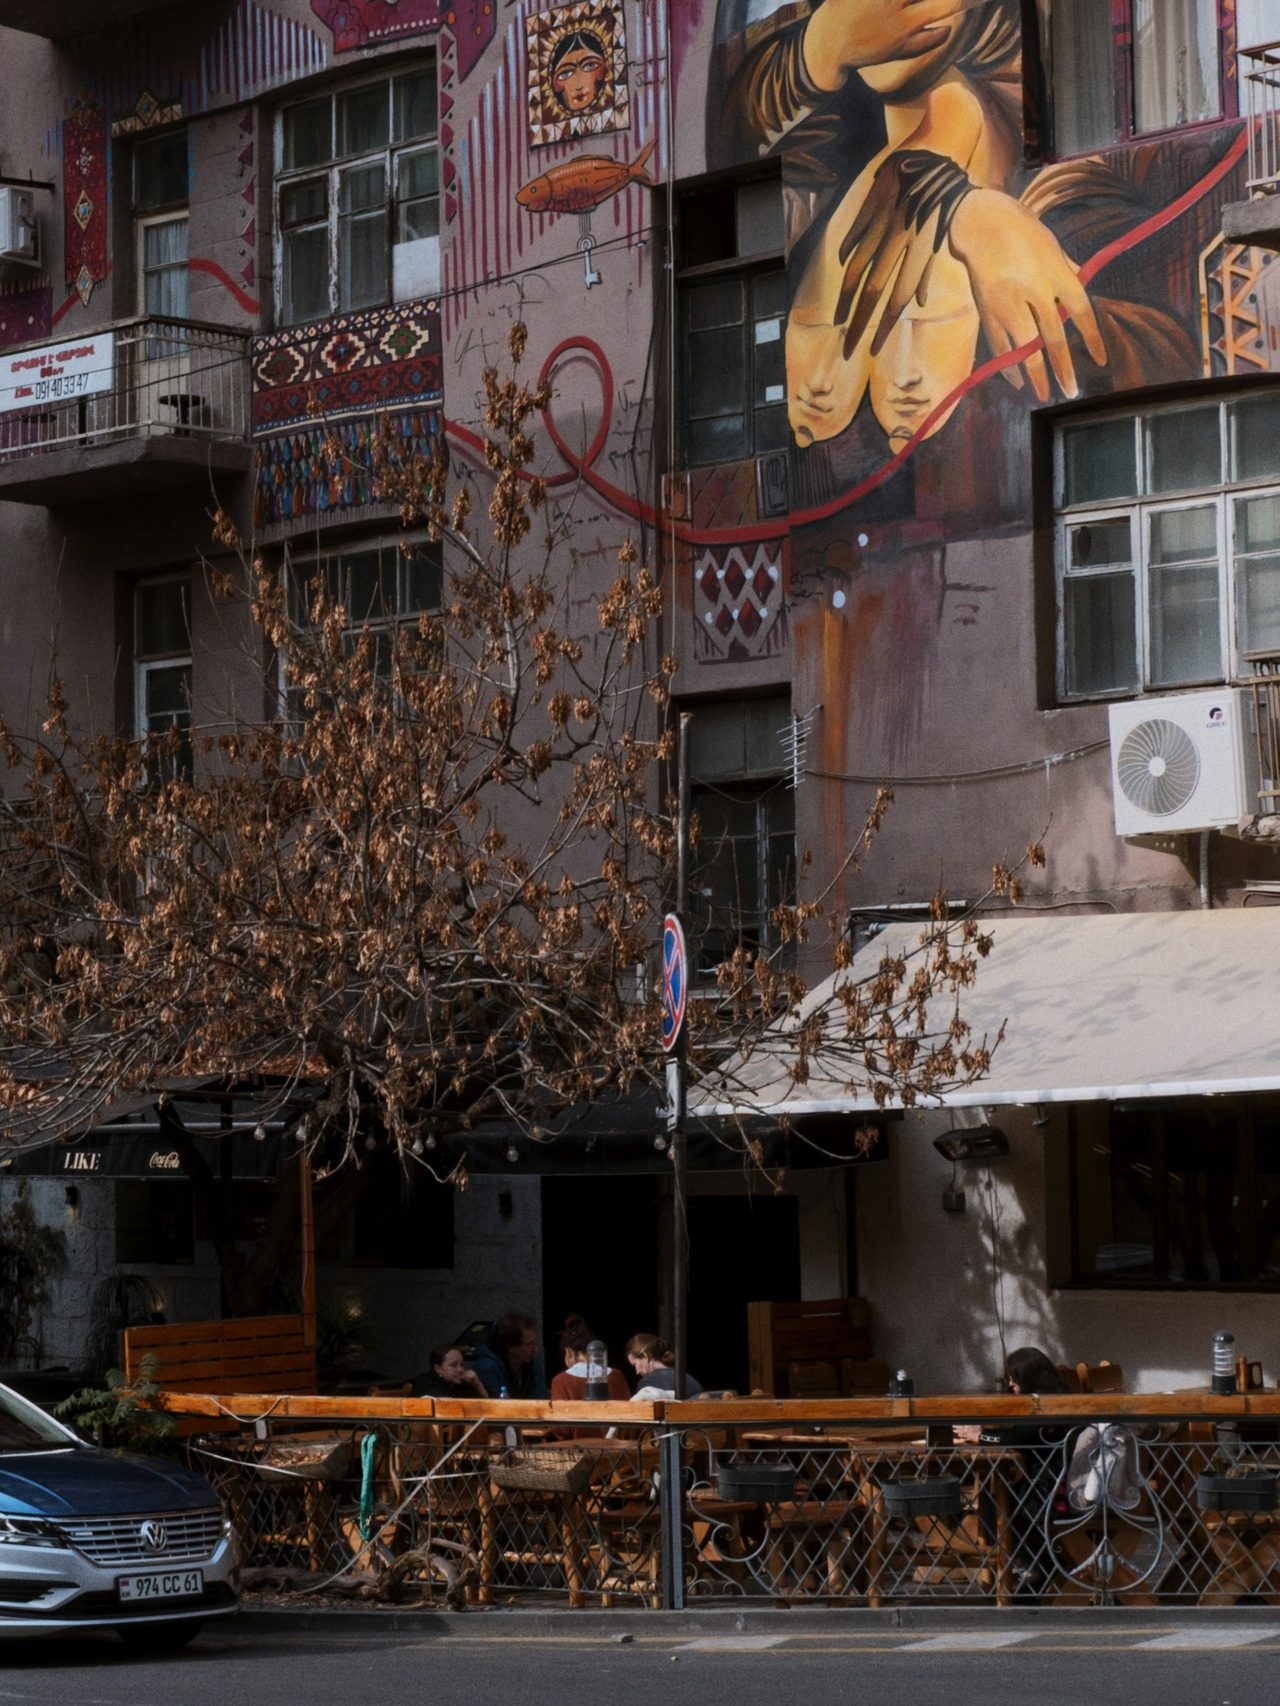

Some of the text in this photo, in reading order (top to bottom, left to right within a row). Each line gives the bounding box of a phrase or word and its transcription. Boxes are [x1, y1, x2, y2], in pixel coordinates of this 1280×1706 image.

[63, 1152, 101, 1170] LIKE
[137, 1574, 199, 1597] 974 CC 61
